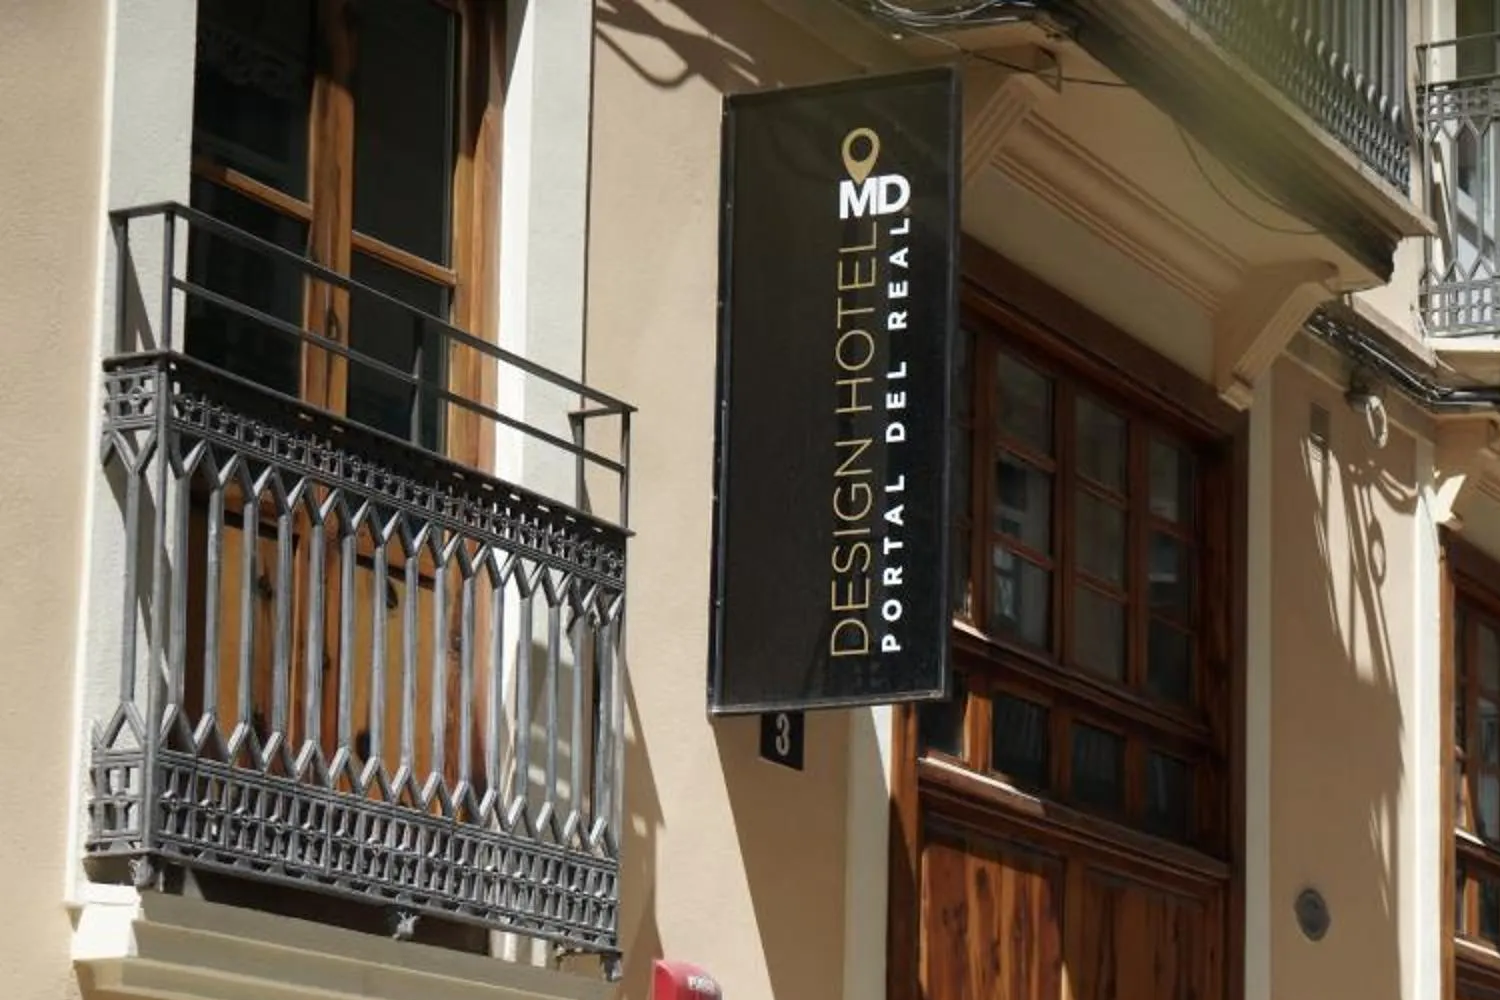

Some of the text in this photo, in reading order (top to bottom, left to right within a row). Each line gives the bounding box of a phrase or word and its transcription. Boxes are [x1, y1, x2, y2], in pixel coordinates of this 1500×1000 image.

[839, 173, 911, 219] MD
[830, 221, 878, 658] DESIGN HOTEL
[881, 217, 911, 653] PORTAL DEL REAL
[776, 713, 790, 756] 3
